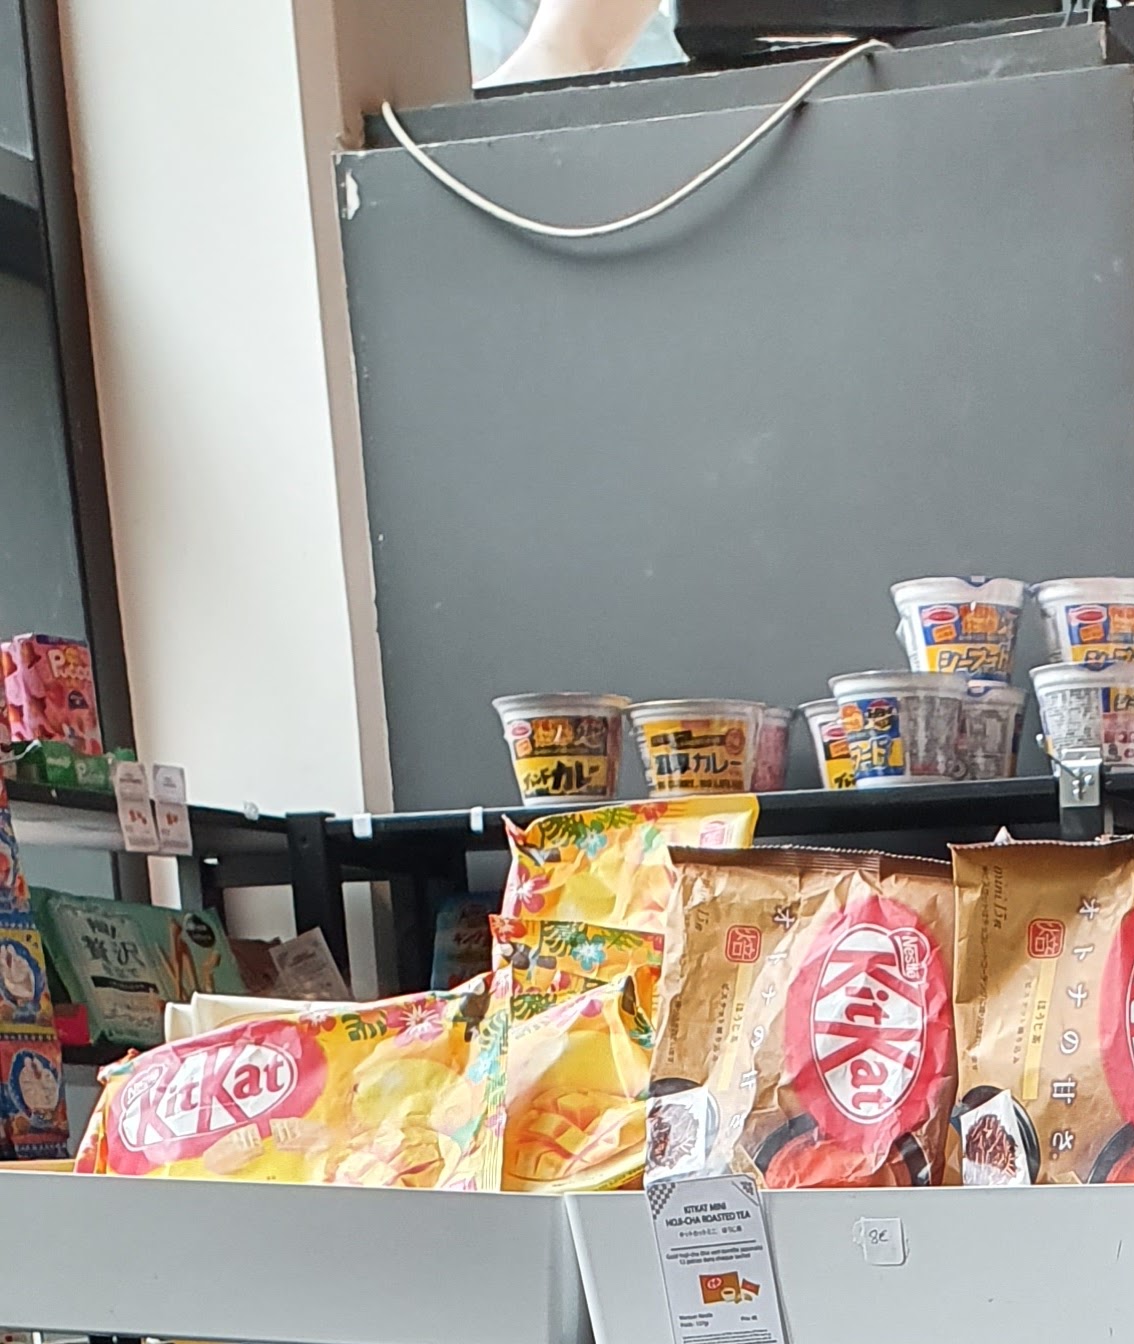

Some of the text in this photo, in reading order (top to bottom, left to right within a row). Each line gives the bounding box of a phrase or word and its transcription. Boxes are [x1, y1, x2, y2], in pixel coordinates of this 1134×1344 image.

[814, 950, 922, 1112] KitKat
[123, 1045, 287, 1148] KitKat
[709, 1202, 726, 1211] MINI
[702, 1211, 751, 1223] ROASTED TEA
[868, 1229, 889, 1244] 8€
